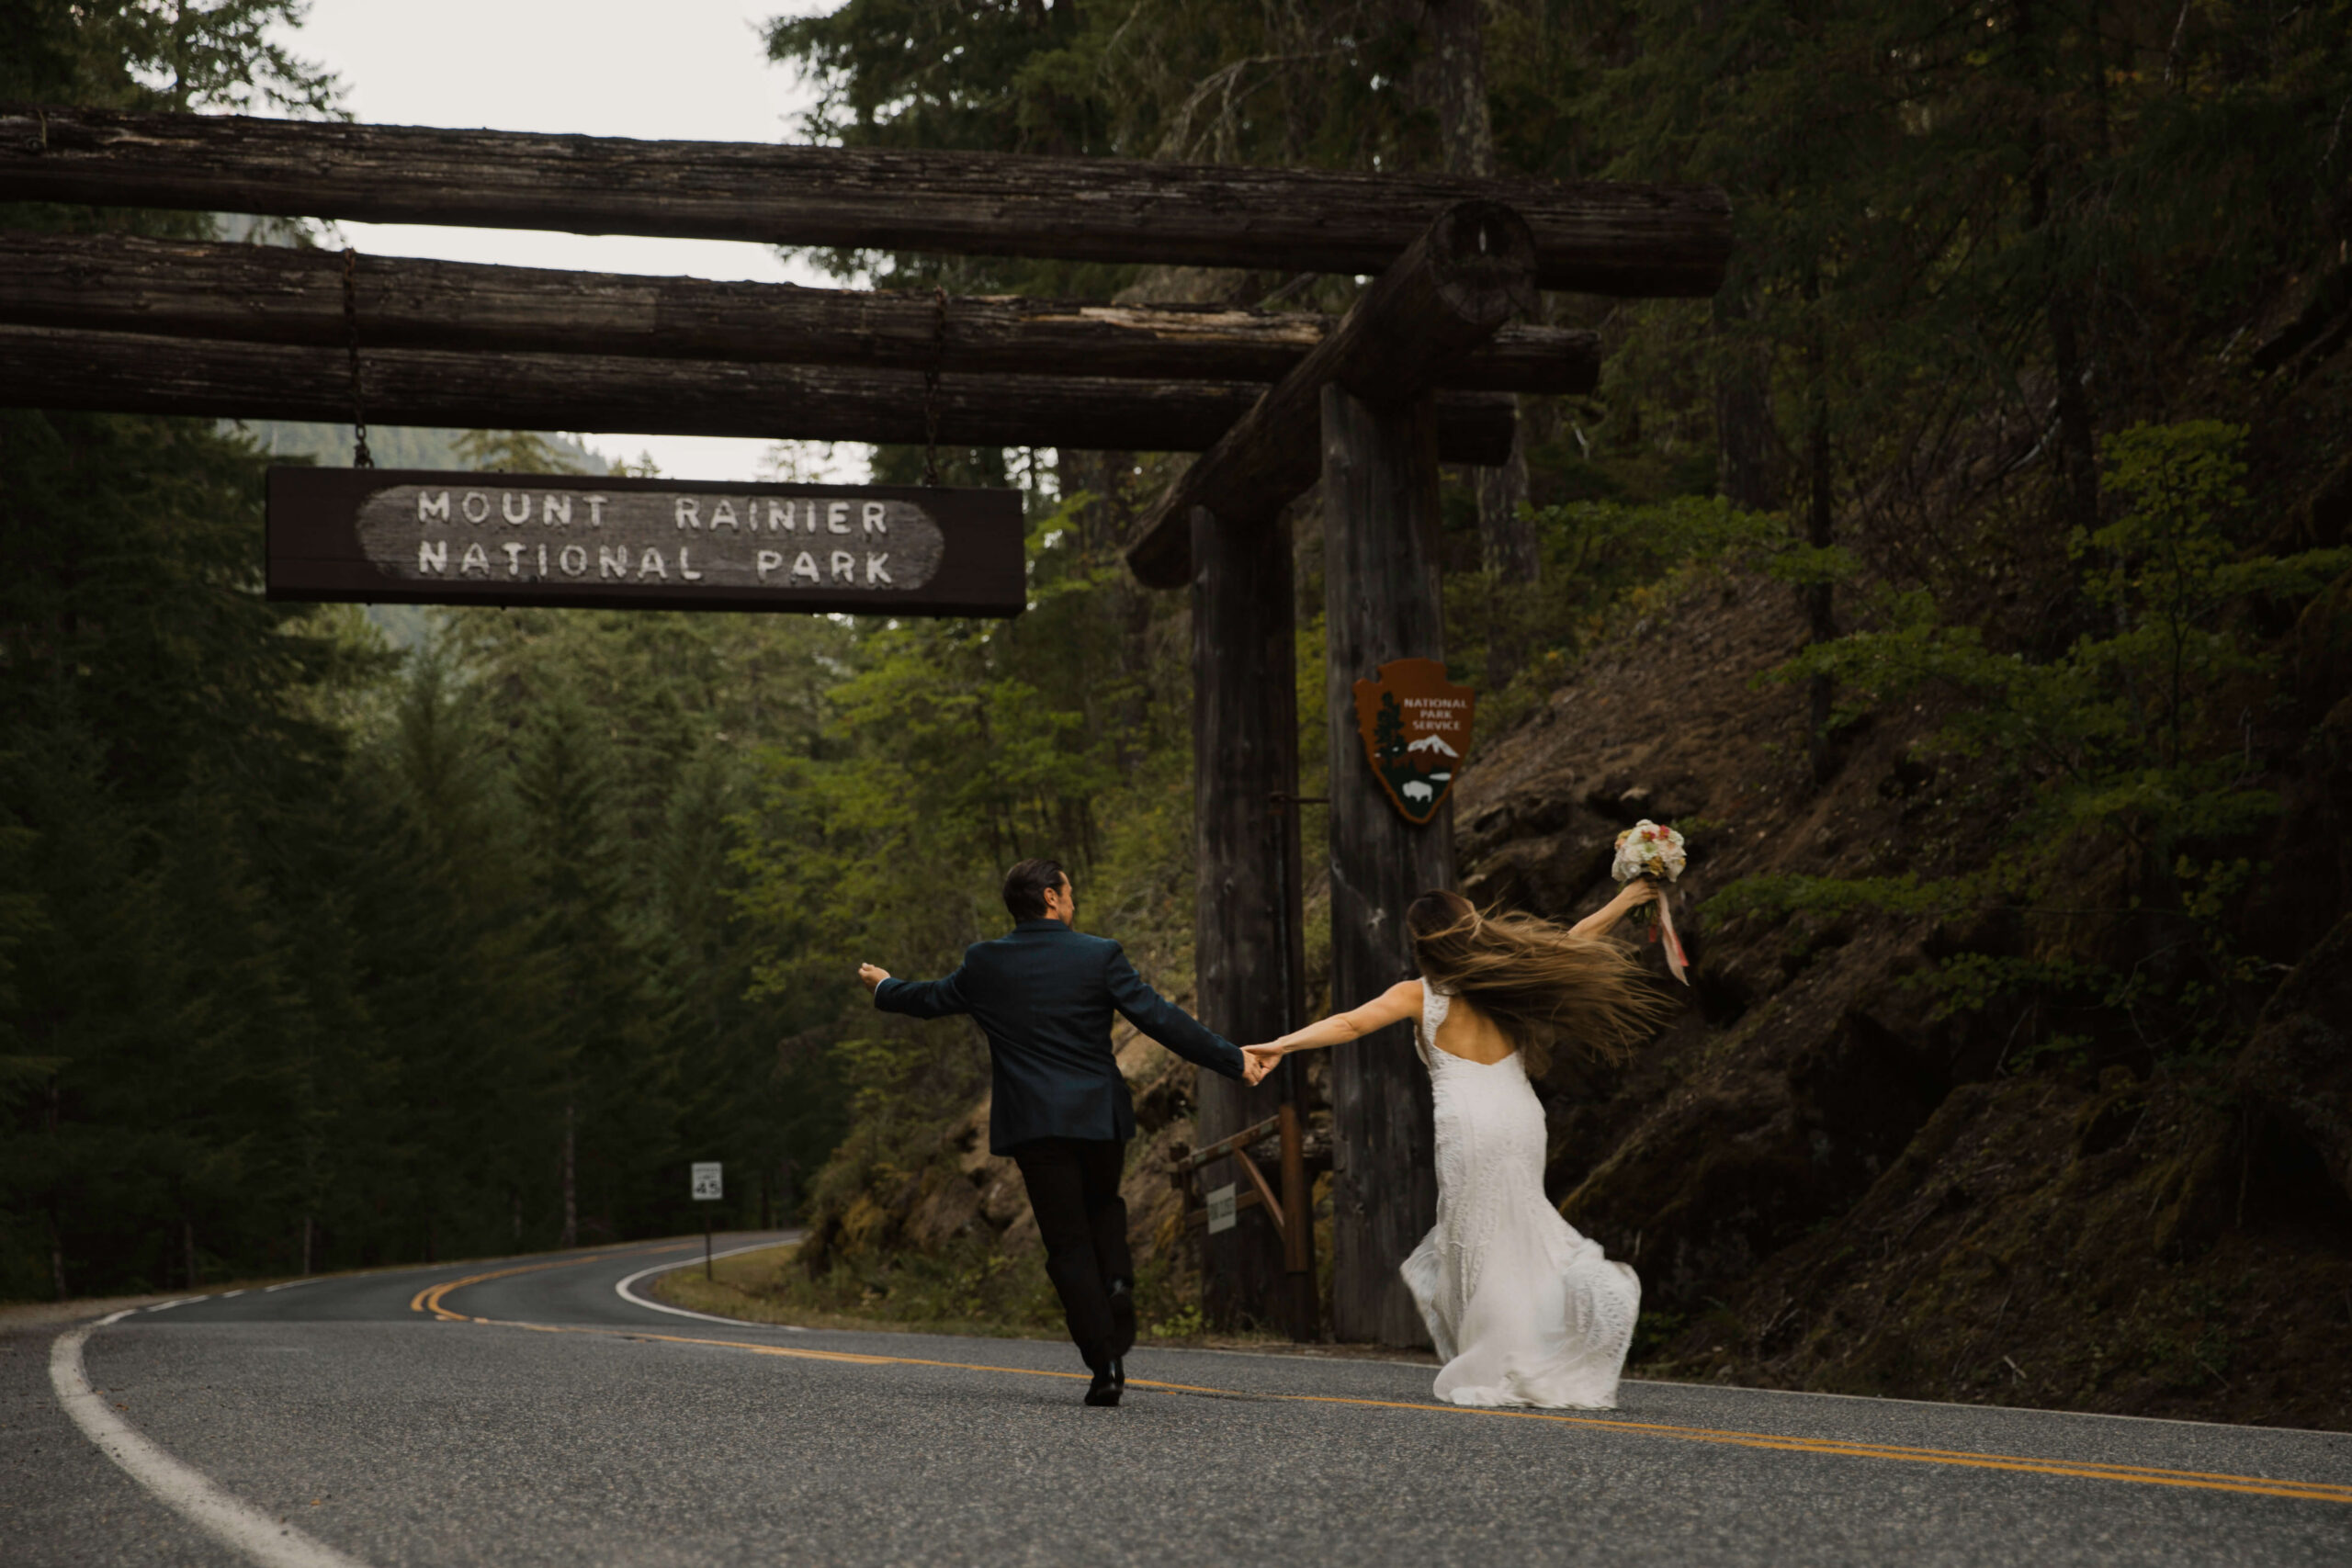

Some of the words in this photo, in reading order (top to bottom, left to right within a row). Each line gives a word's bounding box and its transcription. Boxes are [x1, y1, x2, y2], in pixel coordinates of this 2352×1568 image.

[417, 491, 608, 526] MOUNT
[674, 497, 888, 535] RAINIER
[418, 540, 703, 581] NATIONAL
[756, 550, 892, 584] PARK
[1404, 697, 1468, 709] NATIONAL
[1419, 709, 1453, 719] PARK
[1412, 720, 1461, 731] SERVICE
[695, 1180, 720, 1195] 45
